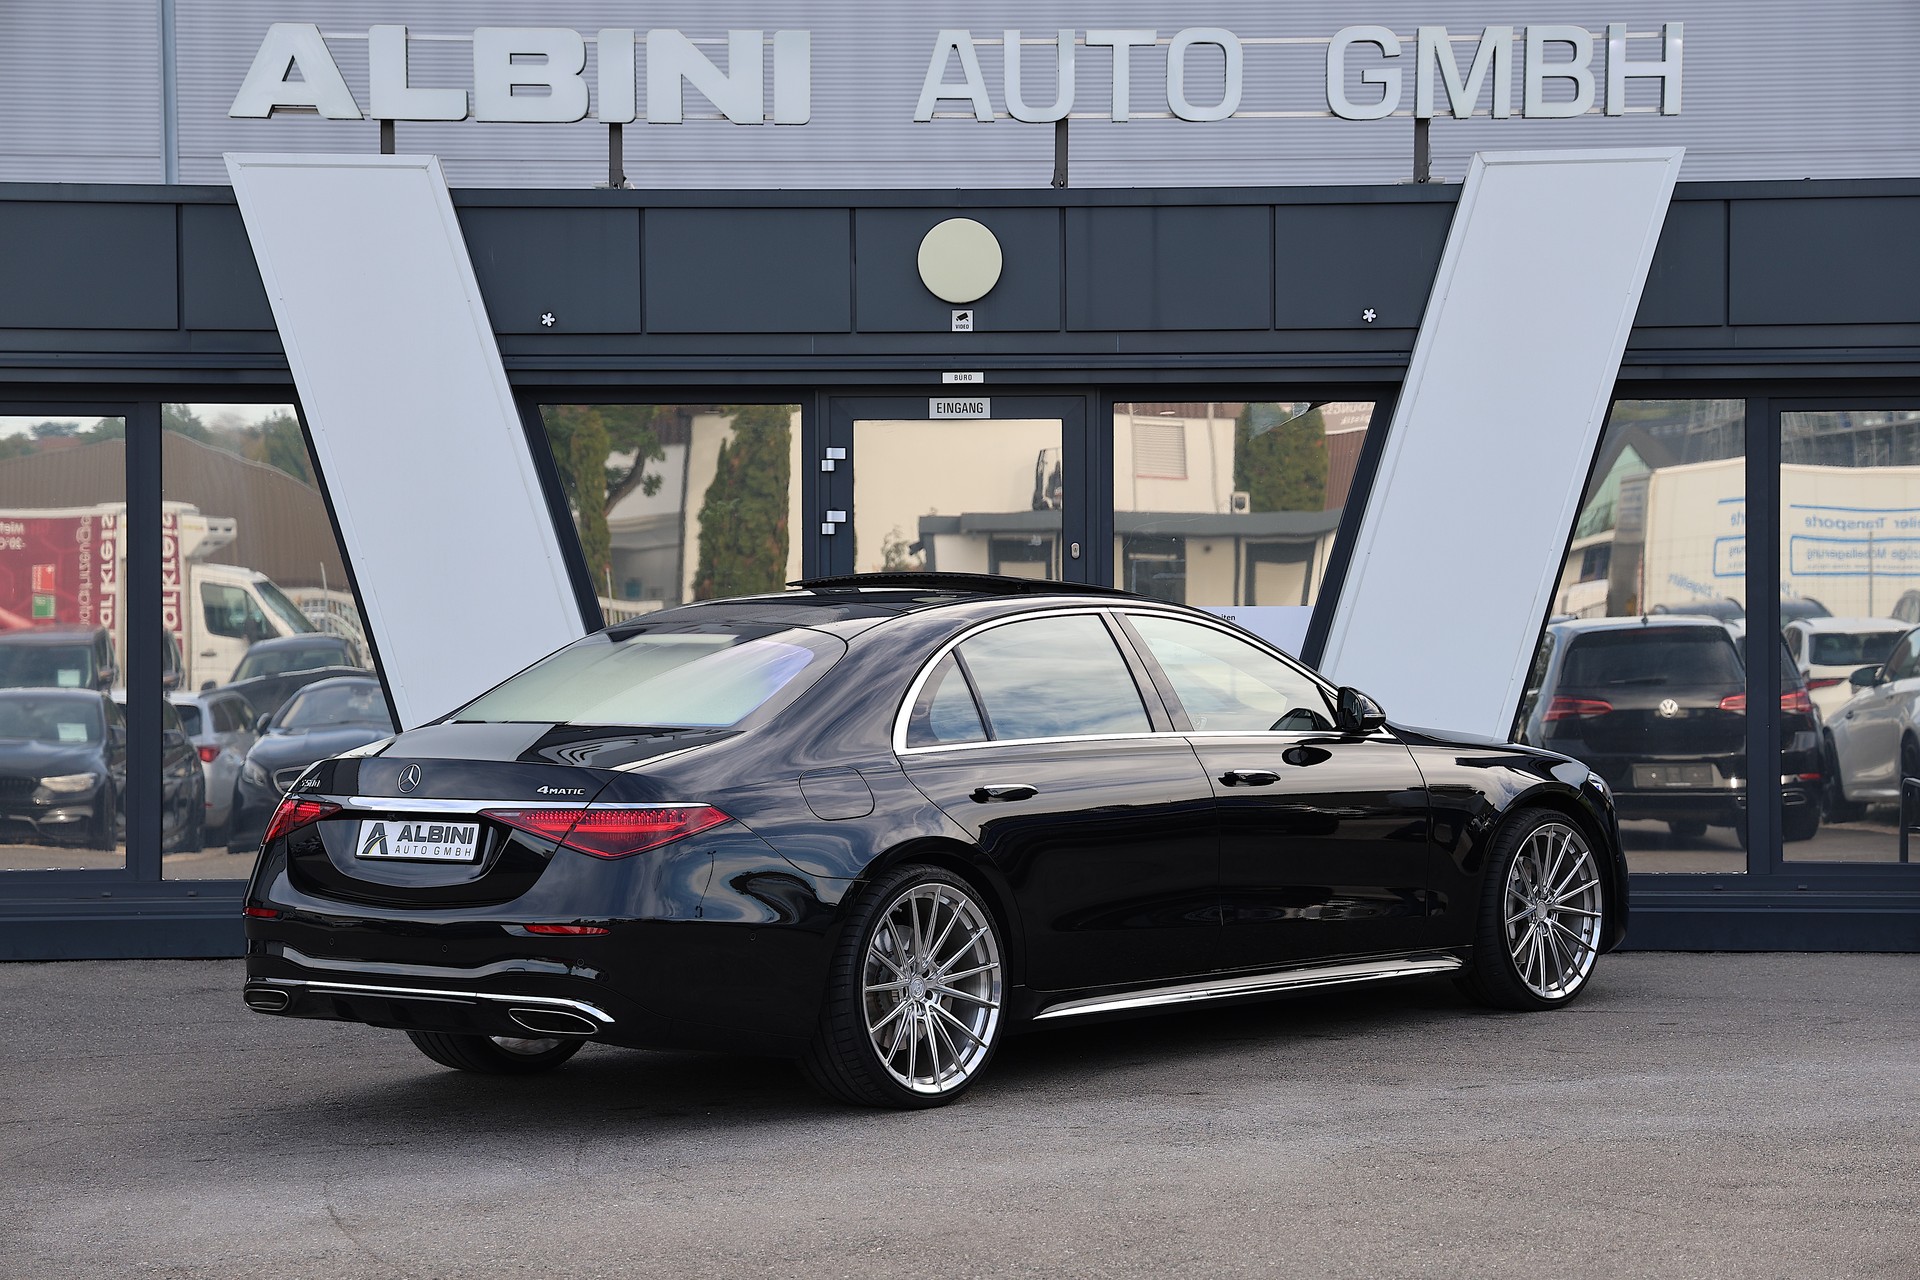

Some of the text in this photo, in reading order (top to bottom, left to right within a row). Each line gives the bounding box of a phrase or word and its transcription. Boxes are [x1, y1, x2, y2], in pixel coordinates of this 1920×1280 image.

[227, 22, 1685, 126] ALBINI AUTO GMBH
[936, 402, 984, 414] EINGANG
[536, 785, 586, 795] 4MATIC
[397, 825, 475, 845] ALBINI
[395, 845, 472, 857] AUTO GMBH
